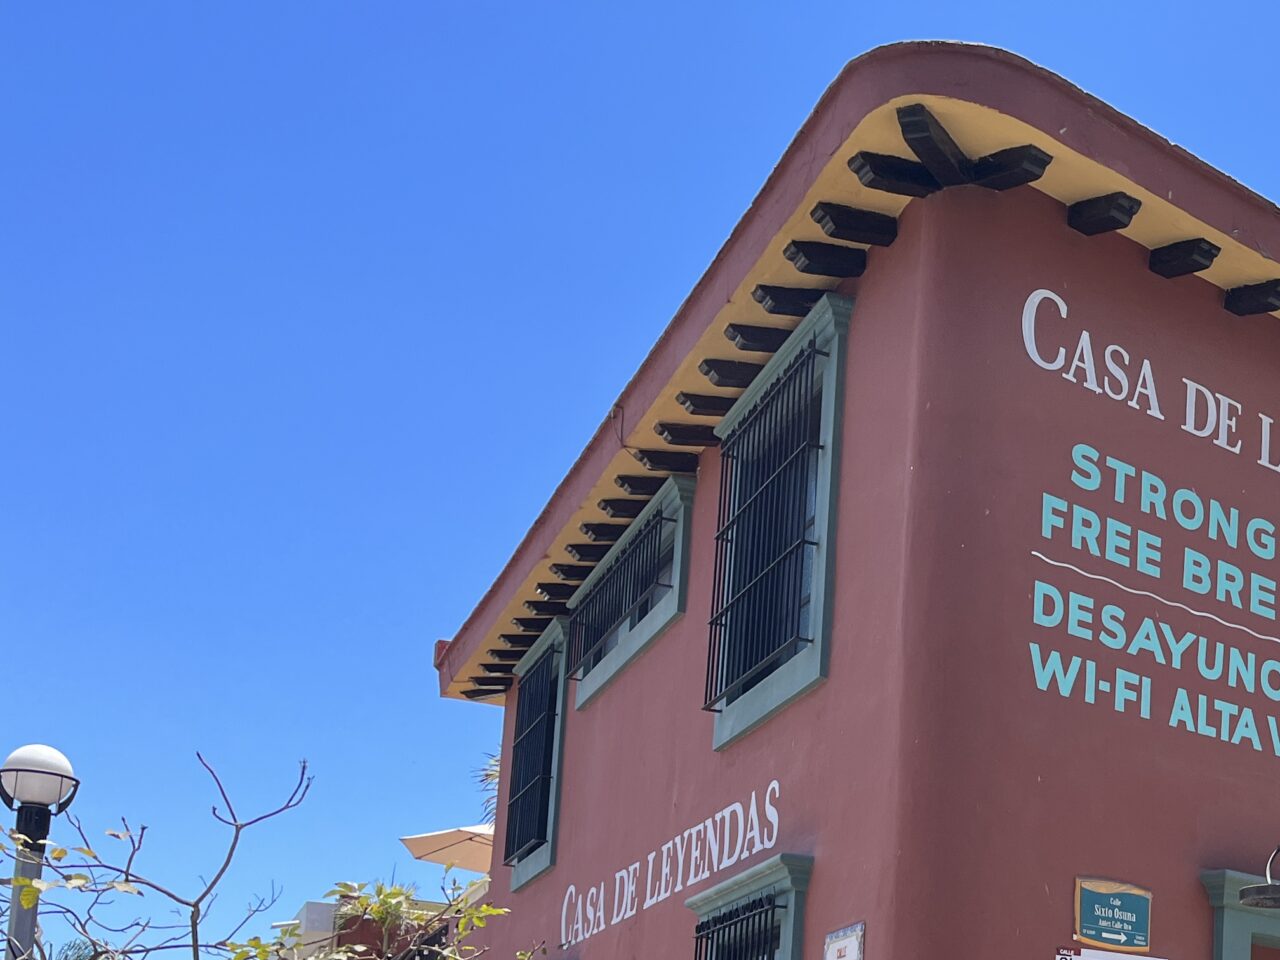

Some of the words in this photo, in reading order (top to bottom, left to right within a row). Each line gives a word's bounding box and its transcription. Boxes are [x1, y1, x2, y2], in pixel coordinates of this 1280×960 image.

[1021, 288, 1165, 421] CASA
[1181, 377, 1243, 455] DE
[1042, 492, 1161, 578] FREE
[1071, 443, 1276, 560] STRONG
[1029, 642, 1152, 720] WI-FI
[1169, 688, 1262, 752] ALTA
[561, 882, 606, 950] CASA
[610, 862, 640, 925] DE
[642, 779, 780, 910] LEYENDAS
[1094, 904, 1113, 918] Sixto
[1114, 908, 1136, 922] Osuna
